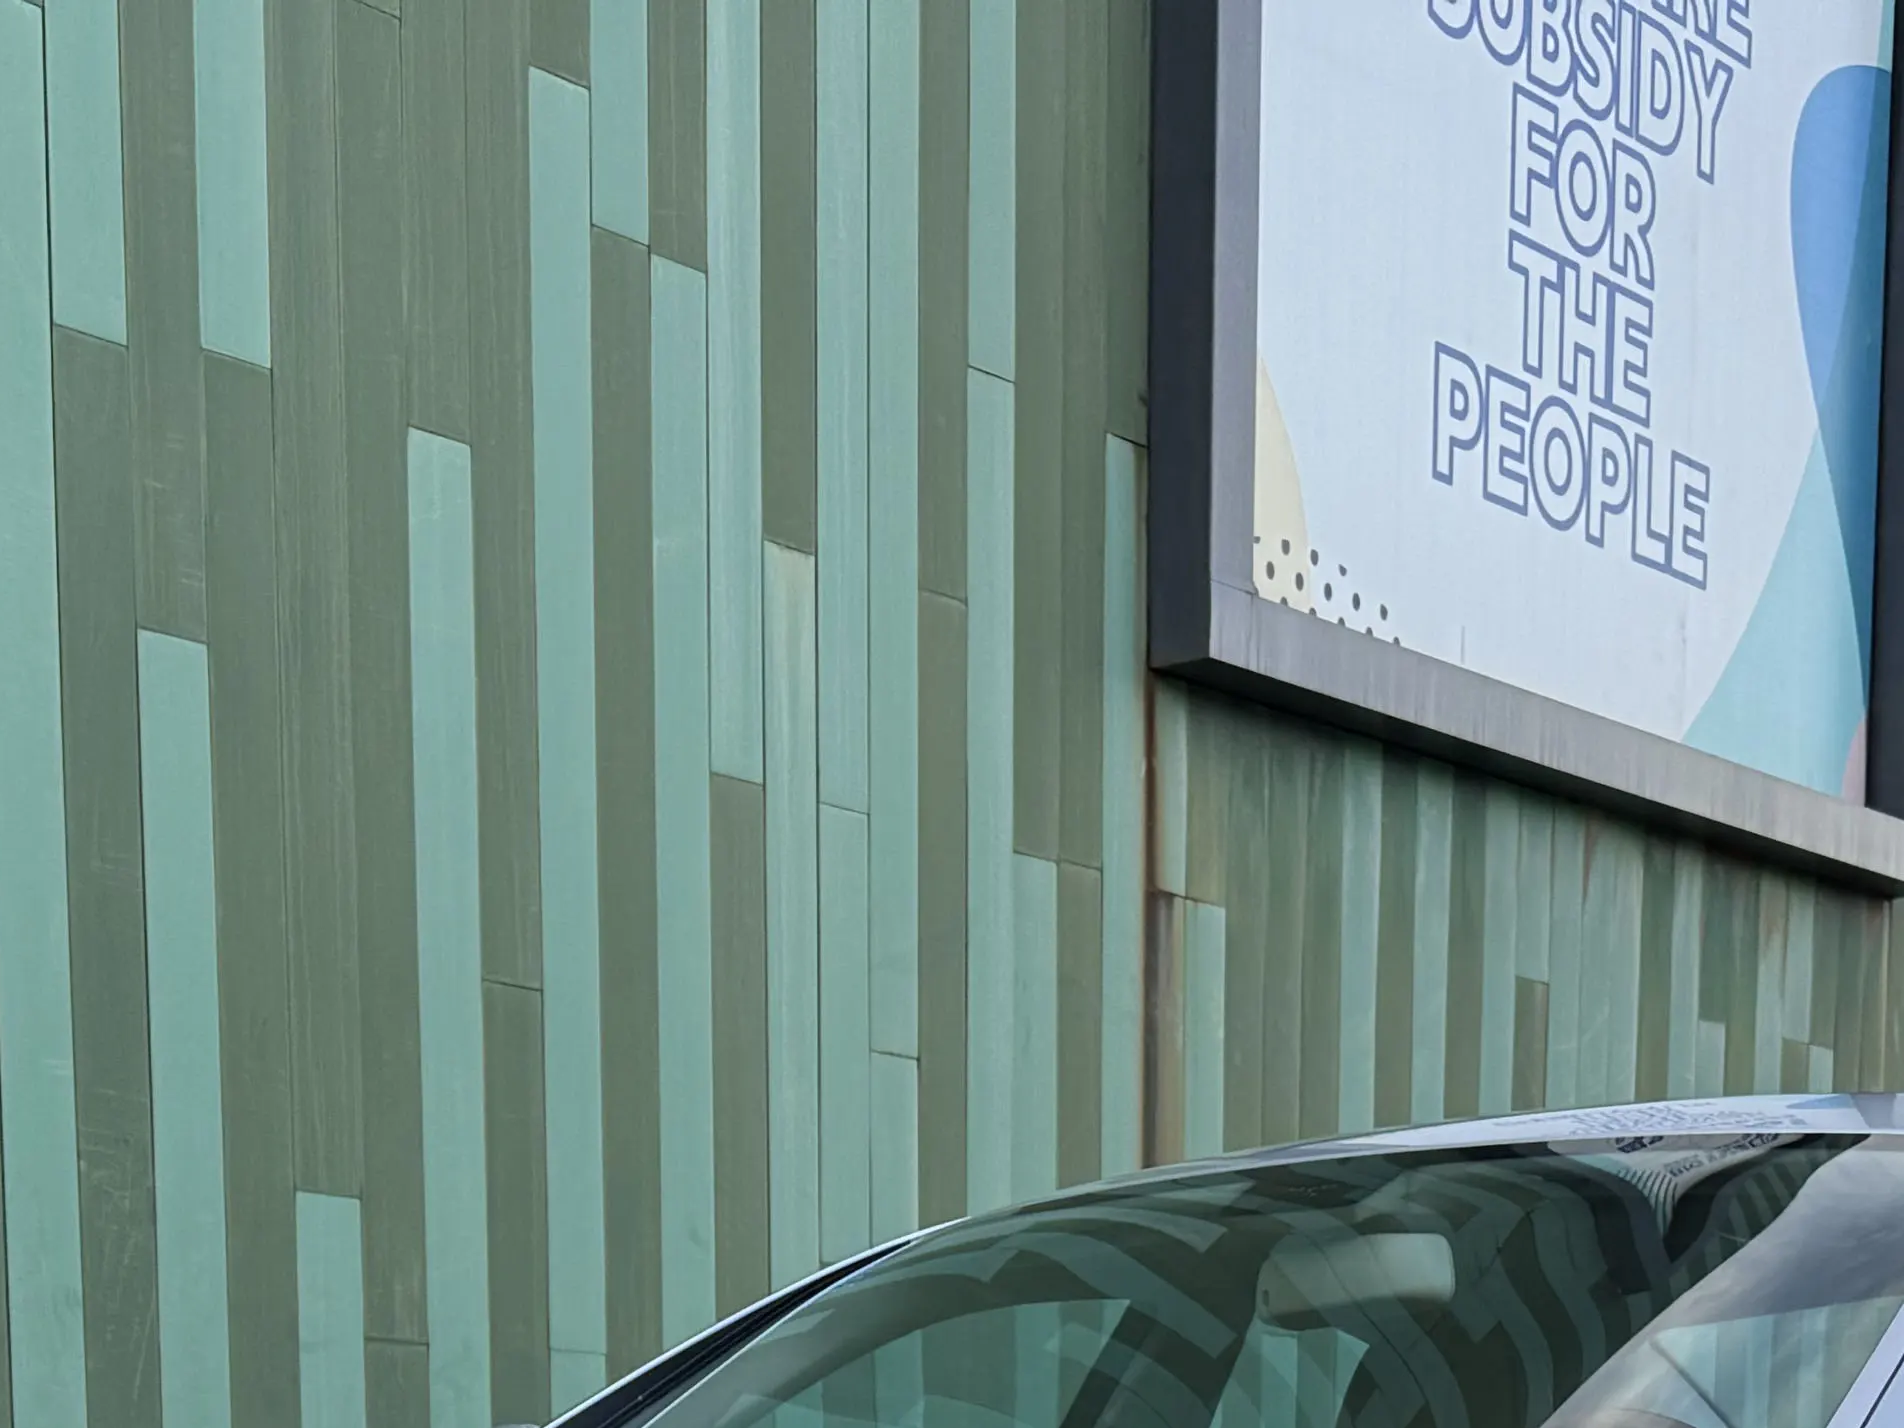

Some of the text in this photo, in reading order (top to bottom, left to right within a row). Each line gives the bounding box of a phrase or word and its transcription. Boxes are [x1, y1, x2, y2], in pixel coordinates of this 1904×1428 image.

[1509, 81, 1657, 291] FOR
[1507, 227, 1654, 428] THE
[1431, 340, 1710, 590] PEOPLE
